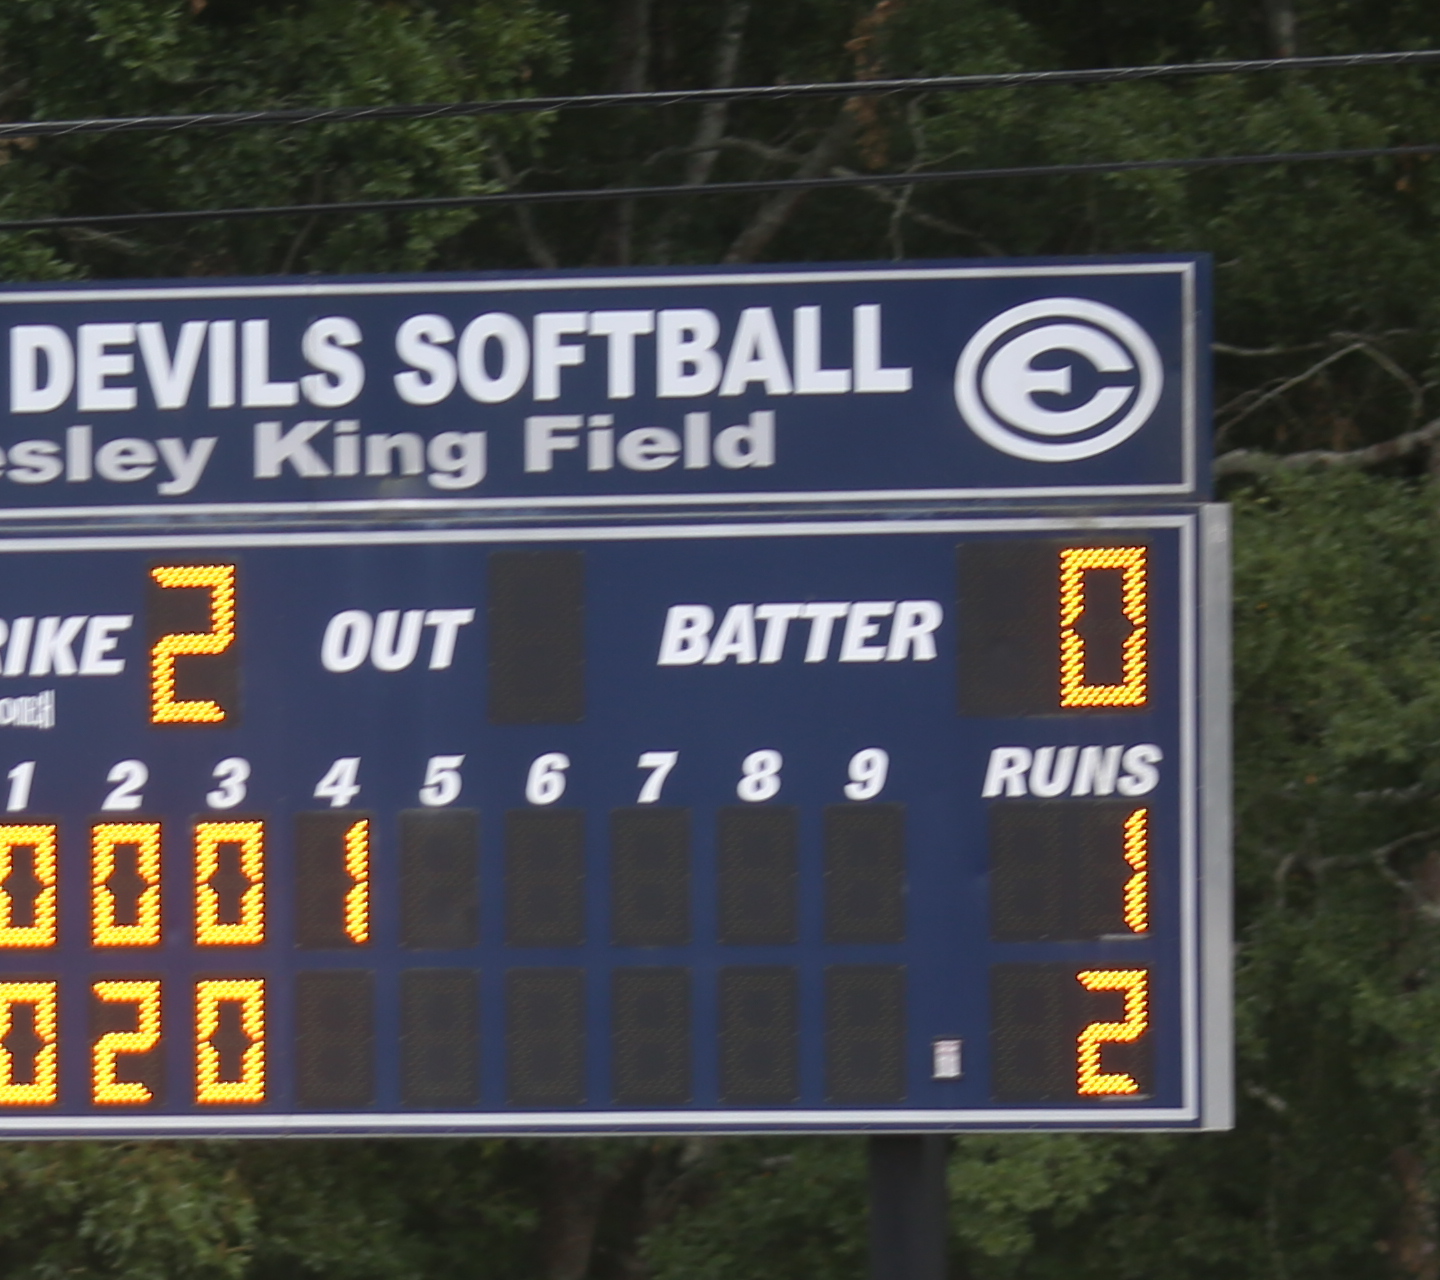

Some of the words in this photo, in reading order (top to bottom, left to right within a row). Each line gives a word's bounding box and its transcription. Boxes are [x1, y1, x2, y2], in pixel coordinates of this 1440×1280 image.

[10, 315, 365, 415] DEVILS
[394, 303, 912, 406] SOFTBALL
[253, 420, 486, 490] King
[524, 410, 777, 474] Field
[148, 564, 236, 725] 2
[321, 607, 474, 674] OUT
[656, 599, 944, 667] BATTER
[1059, 545, 1148, 707] 0
[6, 761, 35, 812] 1
[101, 759, 148, 811] 2
[206, 758, 250, 809] 3
[315, 756, 360, 808] 4
[418, 754, 465, 806] 5
[526, 752, 569, 805] 6
[637, 751, 678, 804] 7
[737, 749, 782, 802] 8
[844, 747, 890, 801] 9
[981, 743, 1164, 800] RUNS
[90, 822, 162, 948] 0
[194, 820, 266, 946] 0
[344, 817, 370, 944] 1
[1123, 808, 1148, 933] 1
[91, 980, 162, 1105] 2
[194, 978, 266, 1104] 0
[1076, 968, 1148, 1096] 2
